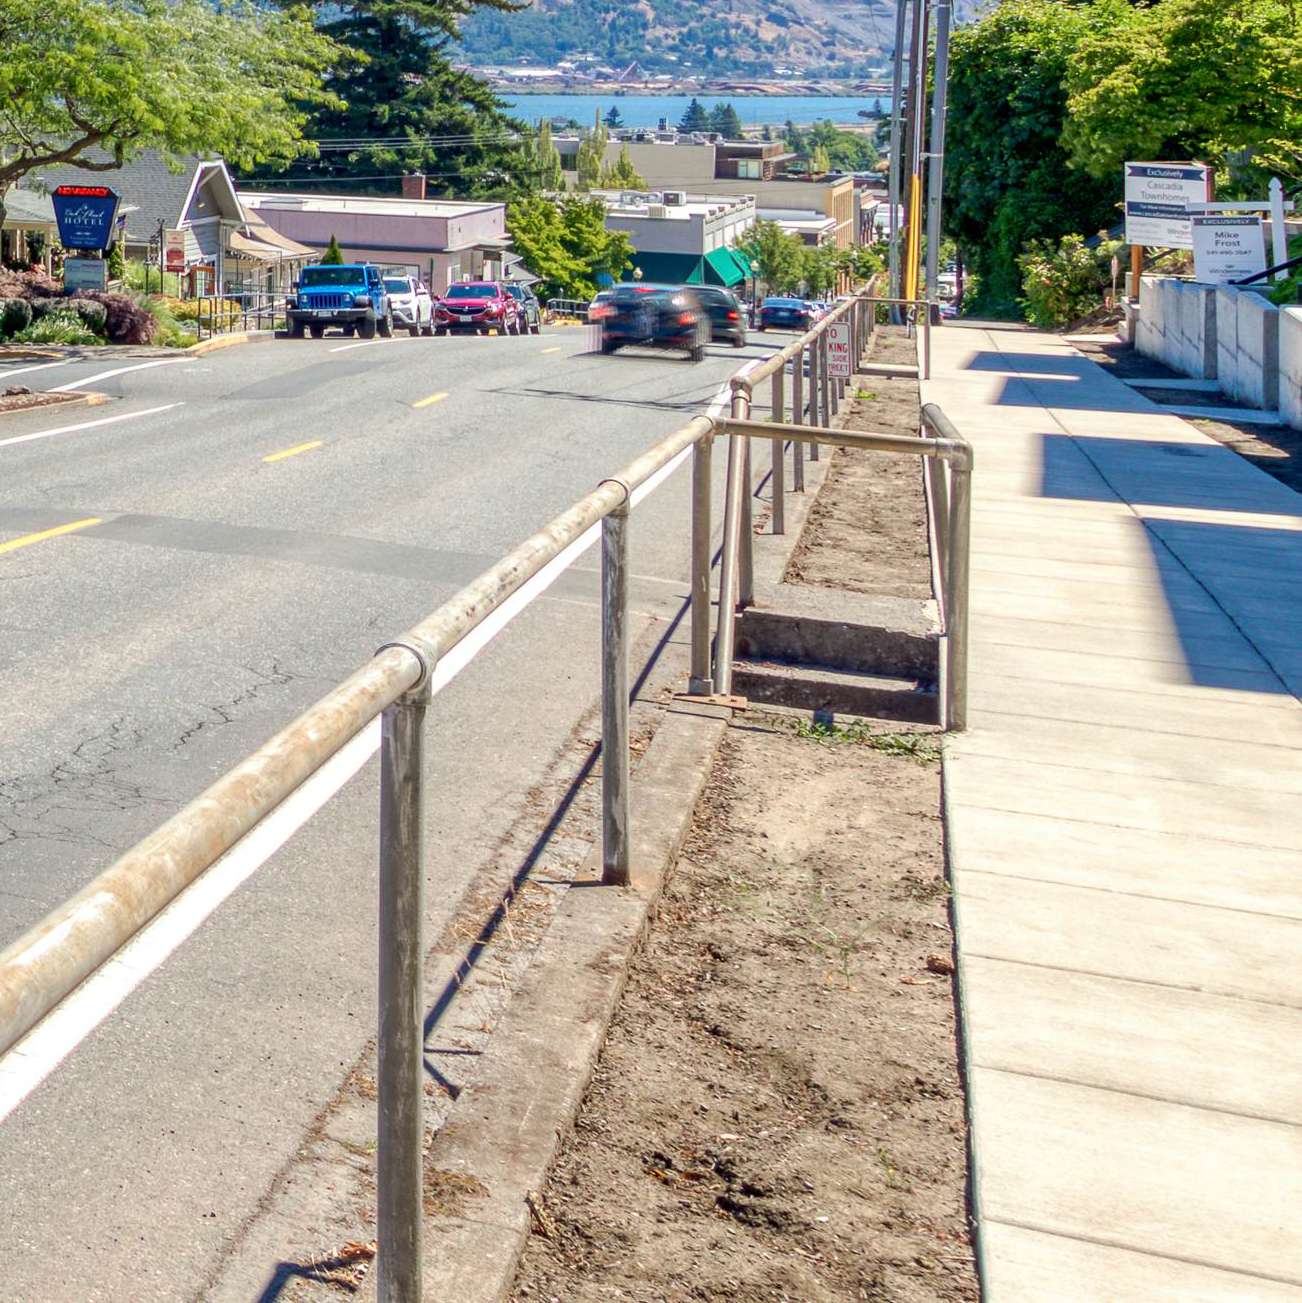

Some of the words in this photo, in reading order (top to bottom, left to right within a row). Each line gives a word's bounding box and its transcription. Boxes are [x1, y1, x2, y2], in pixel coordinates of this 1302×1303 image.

[1147, 168, 1183, 178] Exclusively
[1148, 180, 1183, 191] Cascadia
[1141, 191, 1190, 203] Townhomes
[64, 217, 104, 226] HOTEL
[1215, 239, 1240, 247] Frost
[828, 363, 848, 371] TREET
